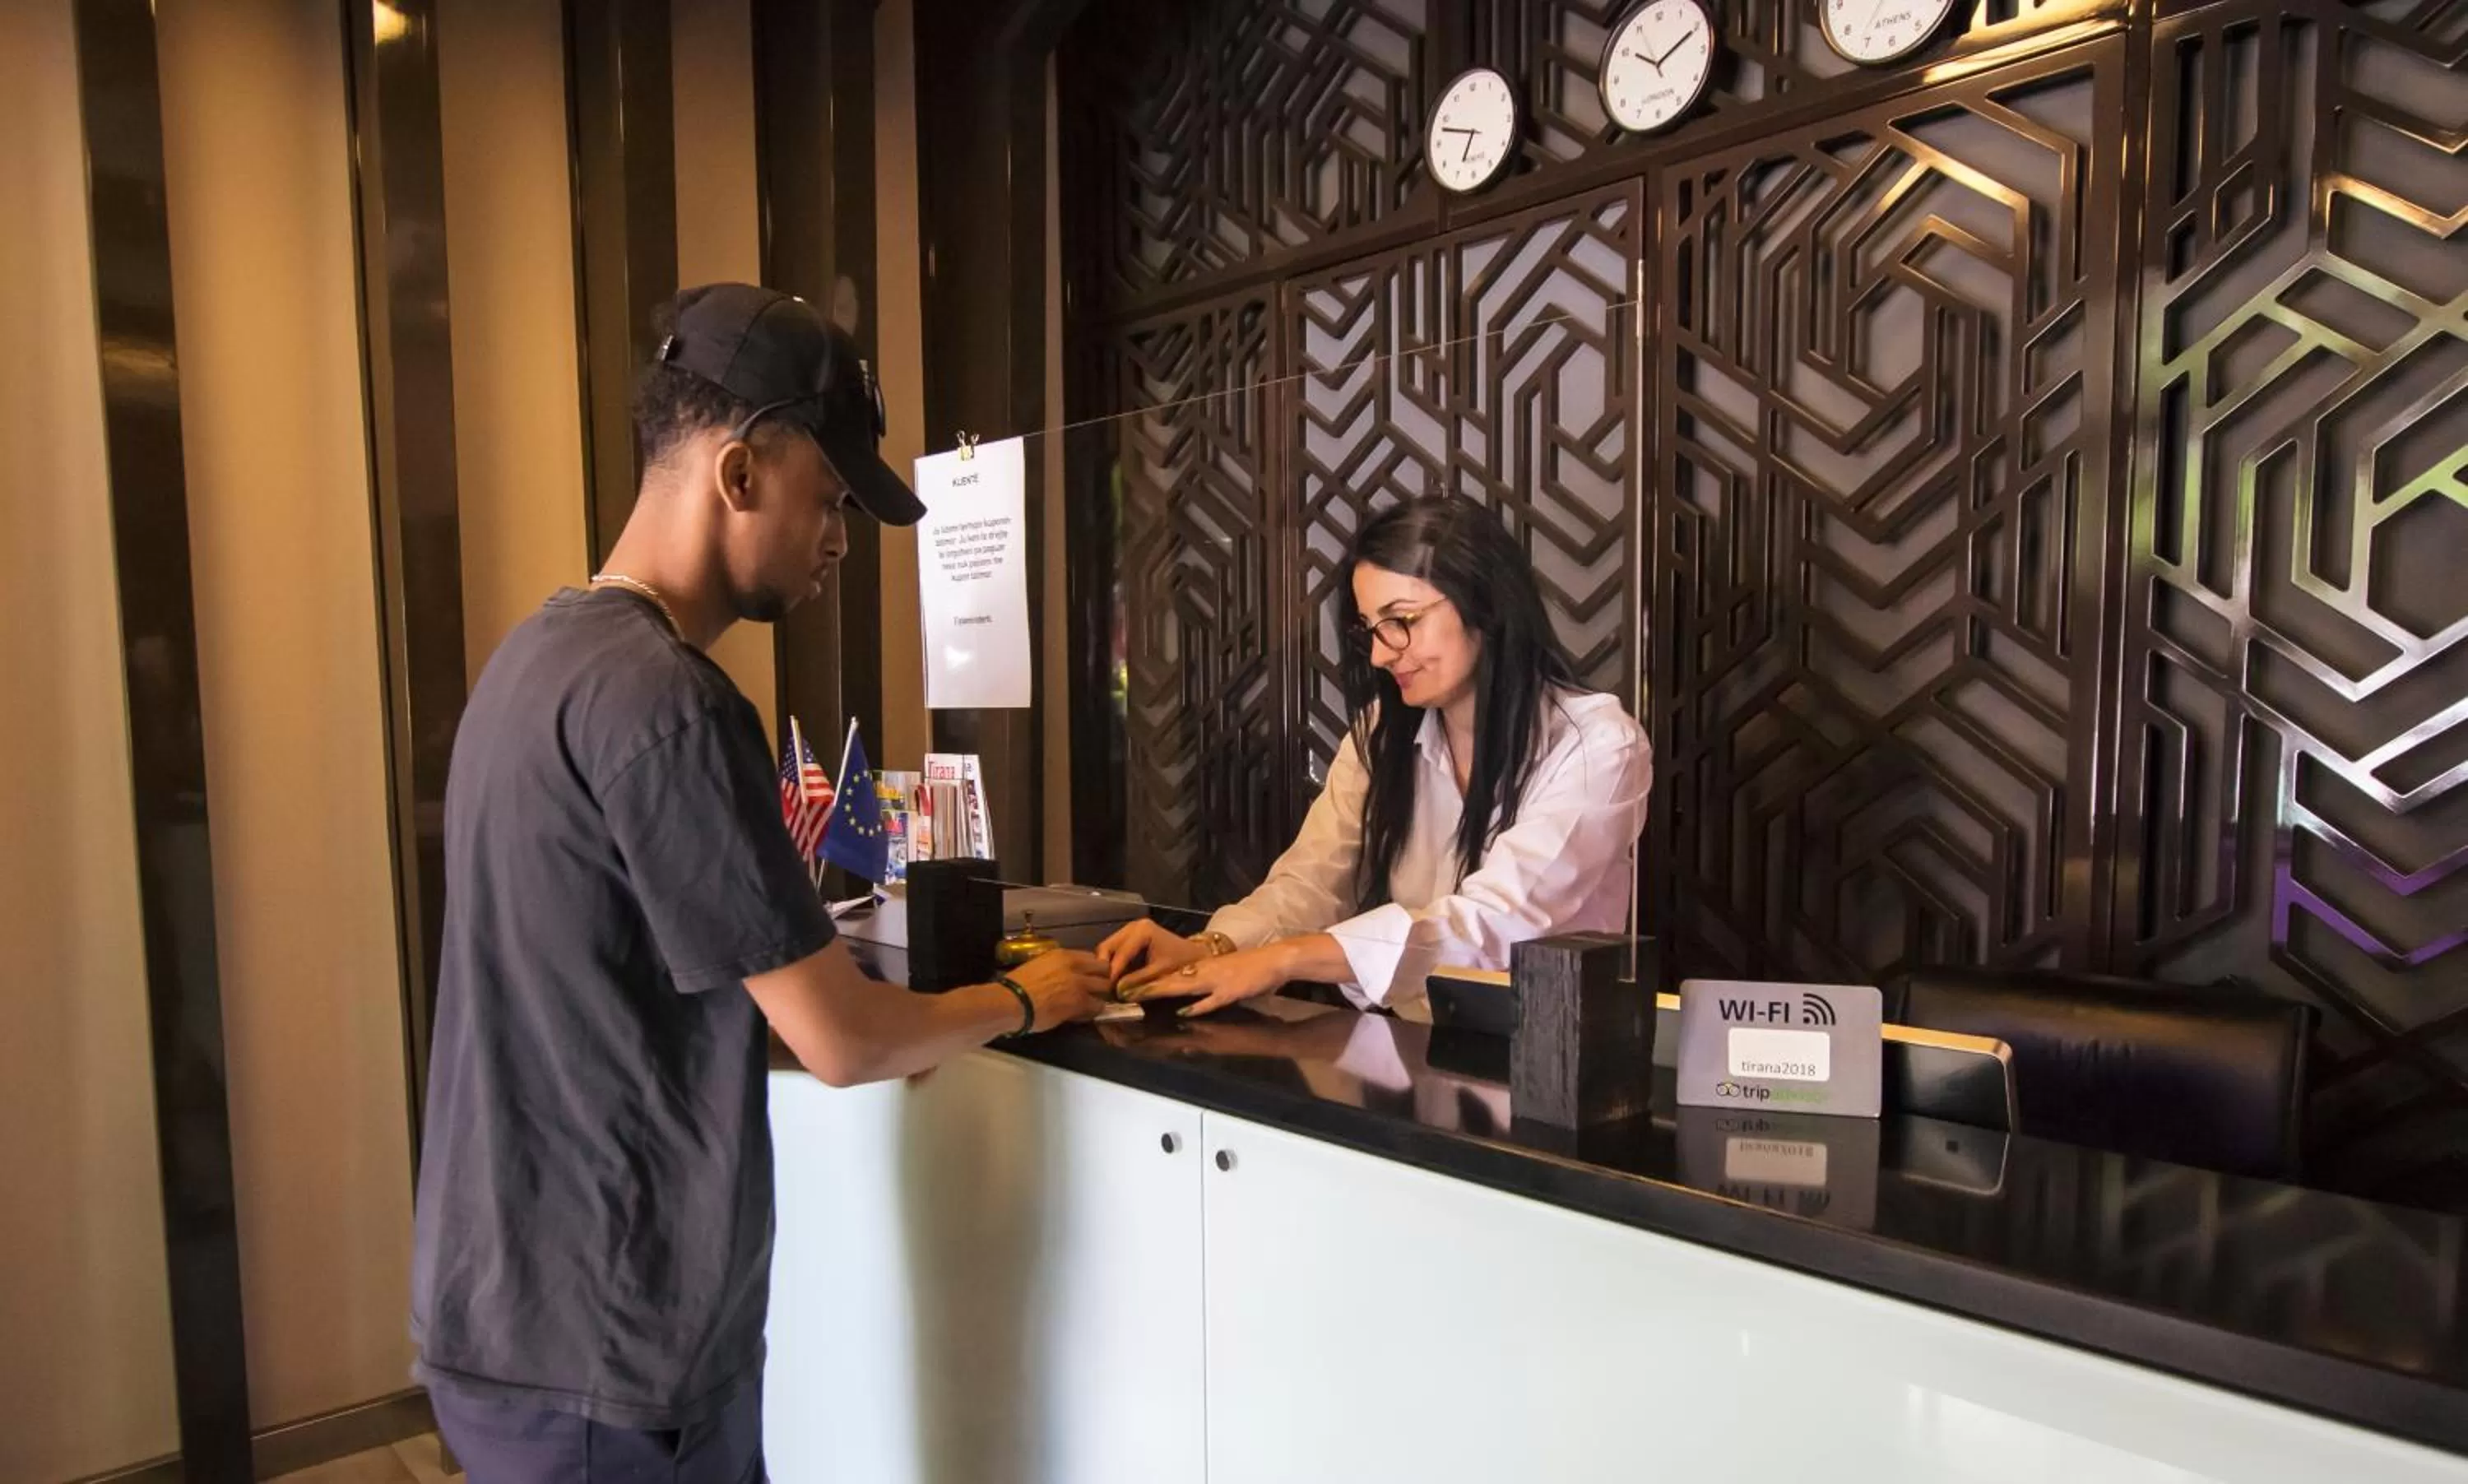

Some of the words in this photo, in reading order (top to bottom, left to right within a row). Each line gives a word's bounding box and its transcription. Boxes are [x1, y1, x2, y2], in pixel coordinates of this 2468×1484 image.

[1874, 12, 1912, 30] ATHENS
[1864, 36, 1872, 48] 7
[1888, 35, 1896, 47] 6
[1719, 999, 1790, 1024] WI-FI
[1742, 1060, 1816, 1077] tirana2018
